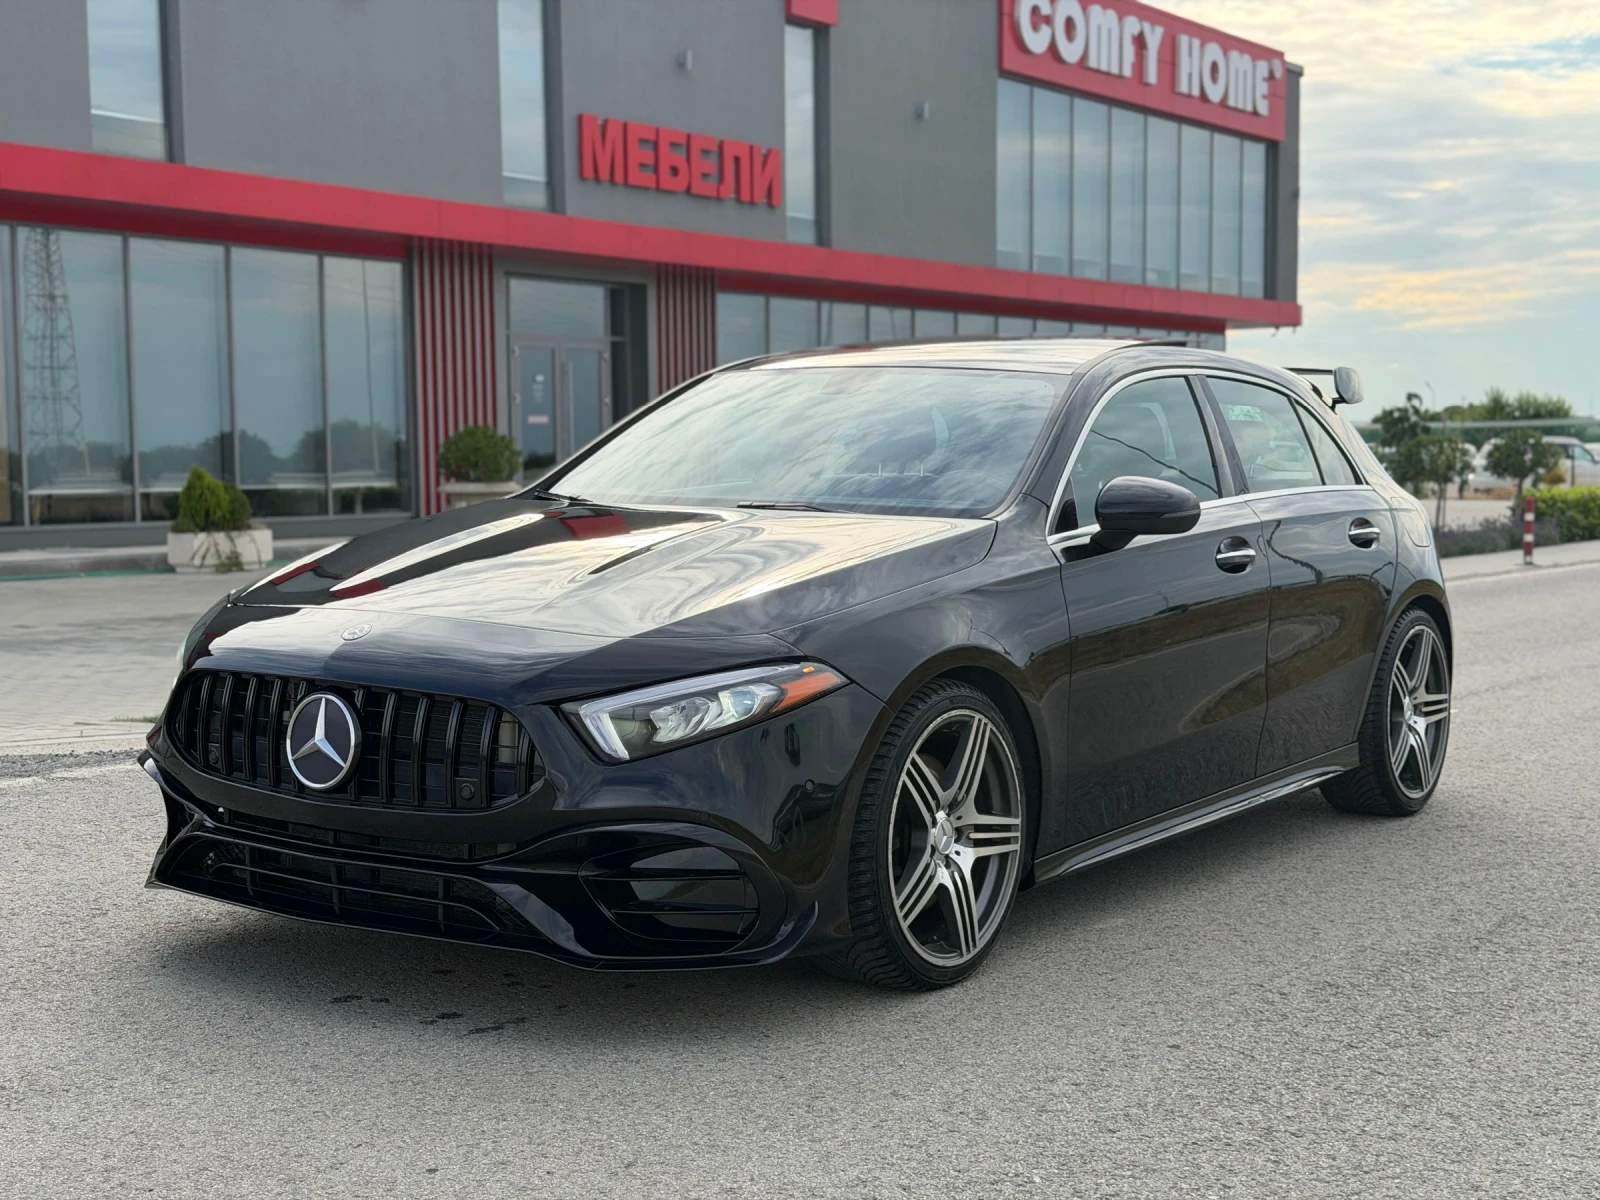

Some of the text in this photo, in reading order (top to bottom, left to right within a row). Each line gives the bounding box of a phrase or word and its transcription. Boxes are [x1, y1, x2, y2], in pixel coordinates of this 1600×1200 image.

[1015, 0, 1269, 117] COMFY HOME
[578, 112, 783, 208] МЕБЕЛИ
